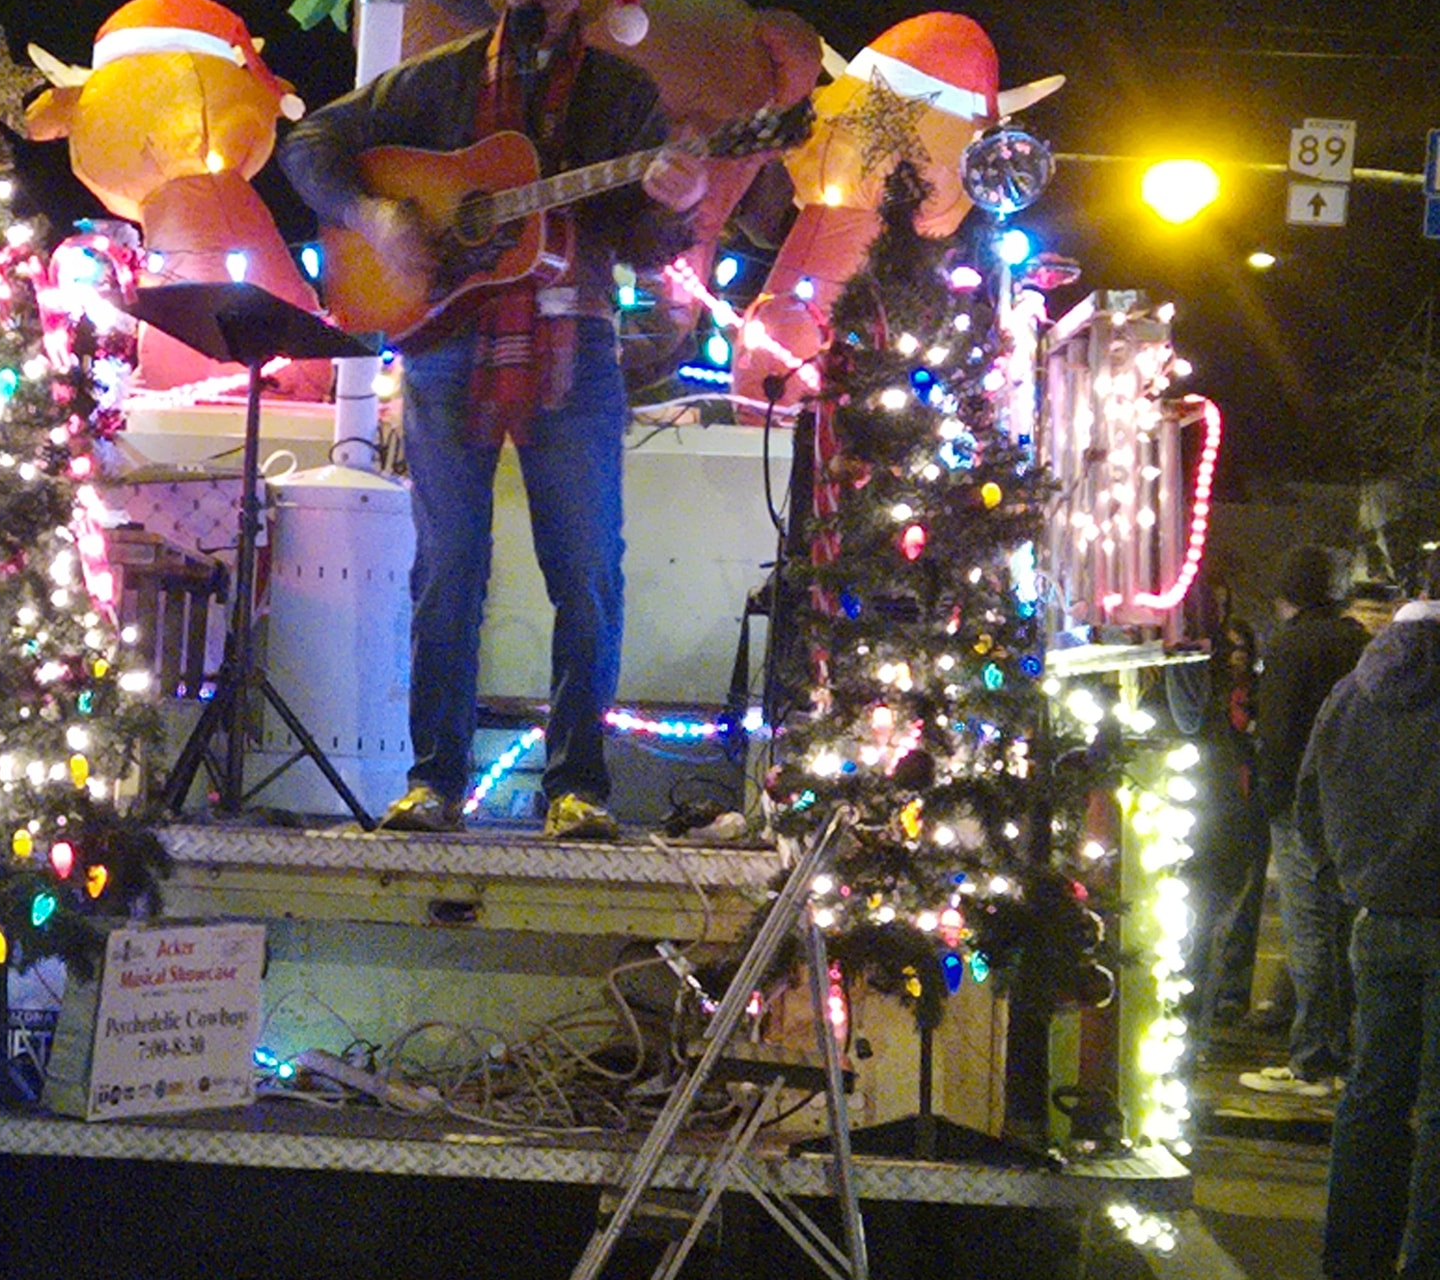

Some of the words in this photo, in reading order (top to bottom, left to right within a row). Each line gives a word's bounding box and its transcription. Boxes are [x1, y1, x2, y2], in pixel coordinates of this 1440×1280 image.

[1299, 135, 1346, 166] 89
[156, 938, 195, 958] Acker
[120, 966, 166, 987] Musical
[170, 965, 237, 983] Showcase
[105, 1009, 181, 1038] Psychedelic
[186, 1007, 249, 1031] Cowboy
